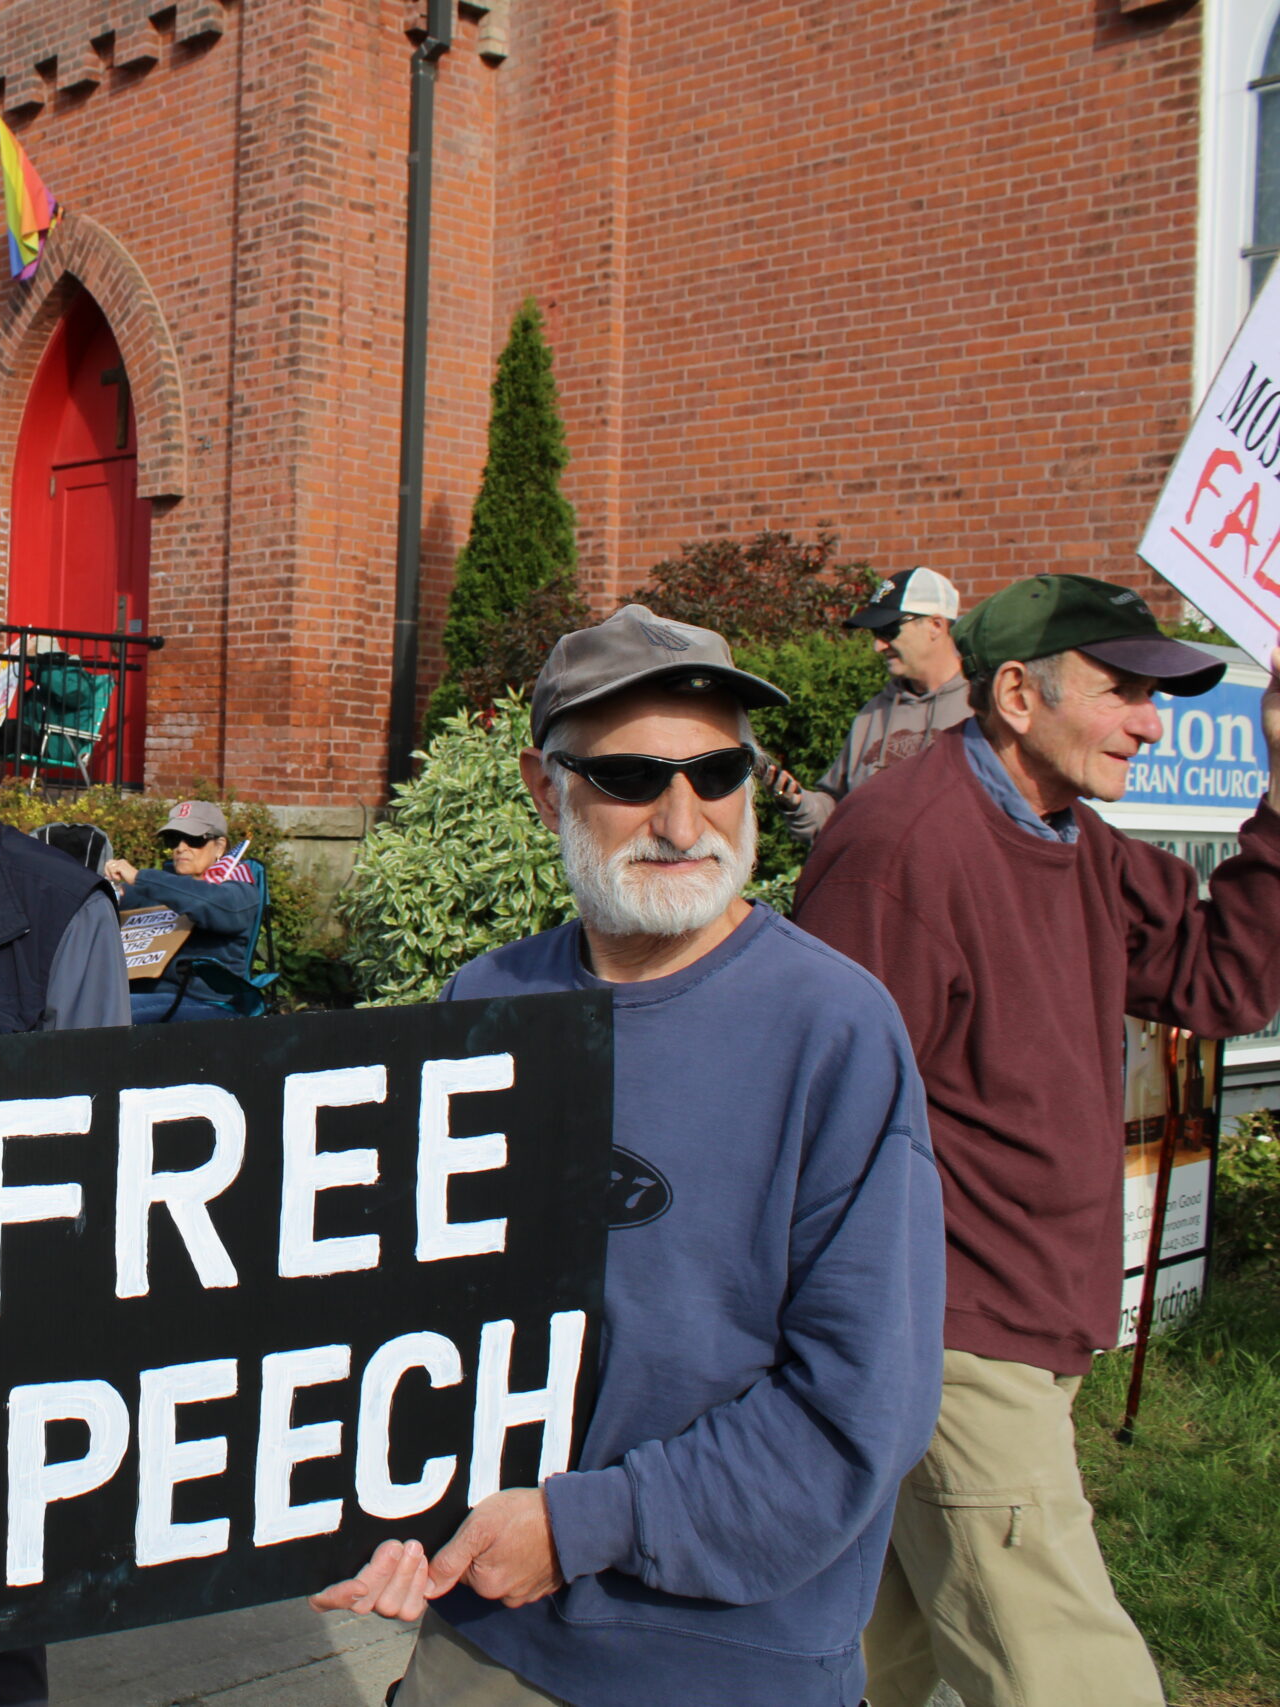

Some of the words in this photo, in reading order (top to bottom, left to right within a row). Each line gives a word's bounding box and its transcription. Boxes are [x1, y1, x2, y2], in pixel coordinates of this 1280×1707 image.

[1137, 690, 1257, 764] ion
[1183, 766, 1270, 799] CHURCH
[177, 803, 192, 818] B
